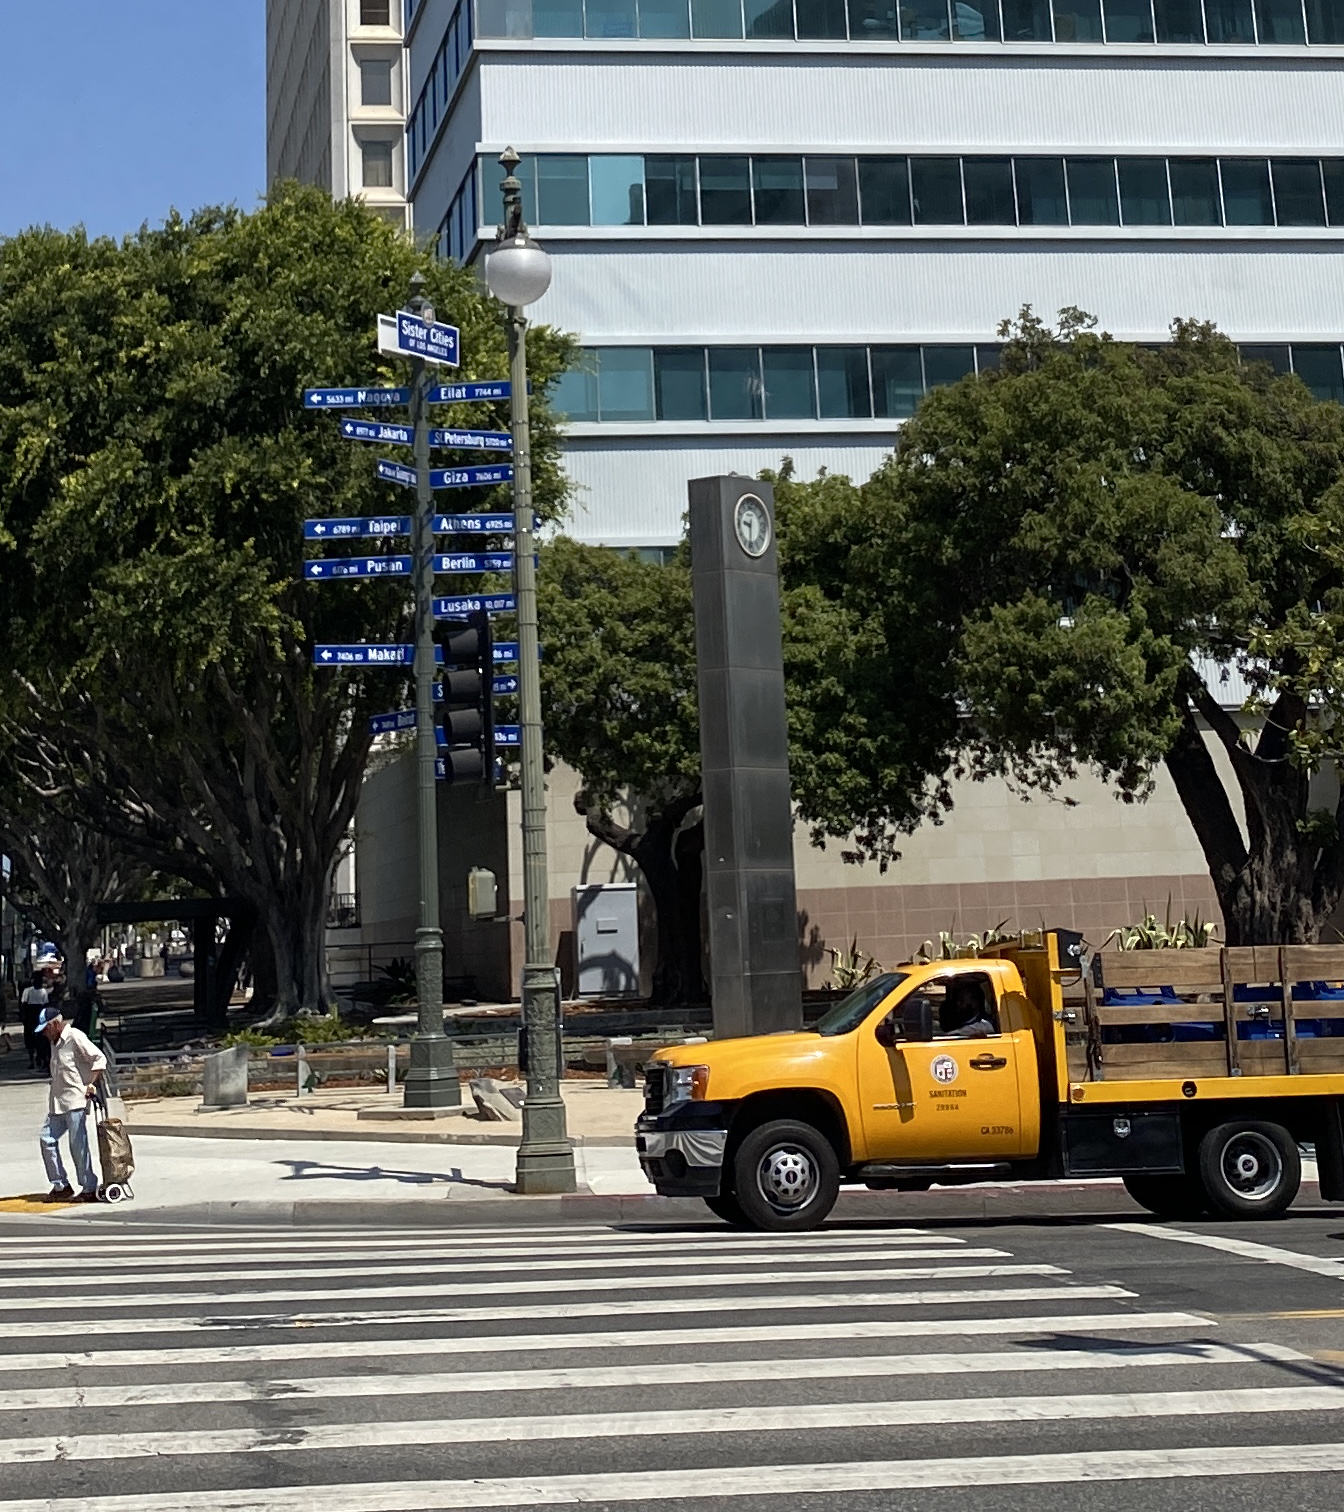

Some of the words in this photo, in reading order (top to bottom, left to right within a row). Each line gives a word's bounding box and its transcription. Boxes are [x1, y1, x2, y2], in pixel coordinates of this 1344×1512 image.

[401, 320, 427, 340] Sister
[430, 328, 455, 348] Cities
[408, 338, 416, 347] OF
[416, 341, 427, 351] LOS
[427, 344, 448, 357] ANGELES
[344, 395, 354, 403] mi
[357, 391, 401, 405] Nagoya
[440, 387, 467, 400] Eilat
[378, 426, 408, 441] Jakarta
[444, 432, 484, 448] Petersburg
[443, 471, 469, 484] Giza
[492, 471, 502, 479] mi
[368, 520, 401, 534] Taipei
[440, 517, 482, 530] Athens
[503, 520, 513, 528] mi
[349, 565, 358, 573] mi
[367, 560, 403, 573] Pusan
[441, 556, 476, 569] Berlin
[440, 599, 481, 613] Lusaka
[505, 599, 515, 607] mi
[355, 652, 364, 661] mi
[503, 650, 514, 658] mi
[507, 733, 517, 741] mi
[929, 1089, 967, 1098] SANITATION
